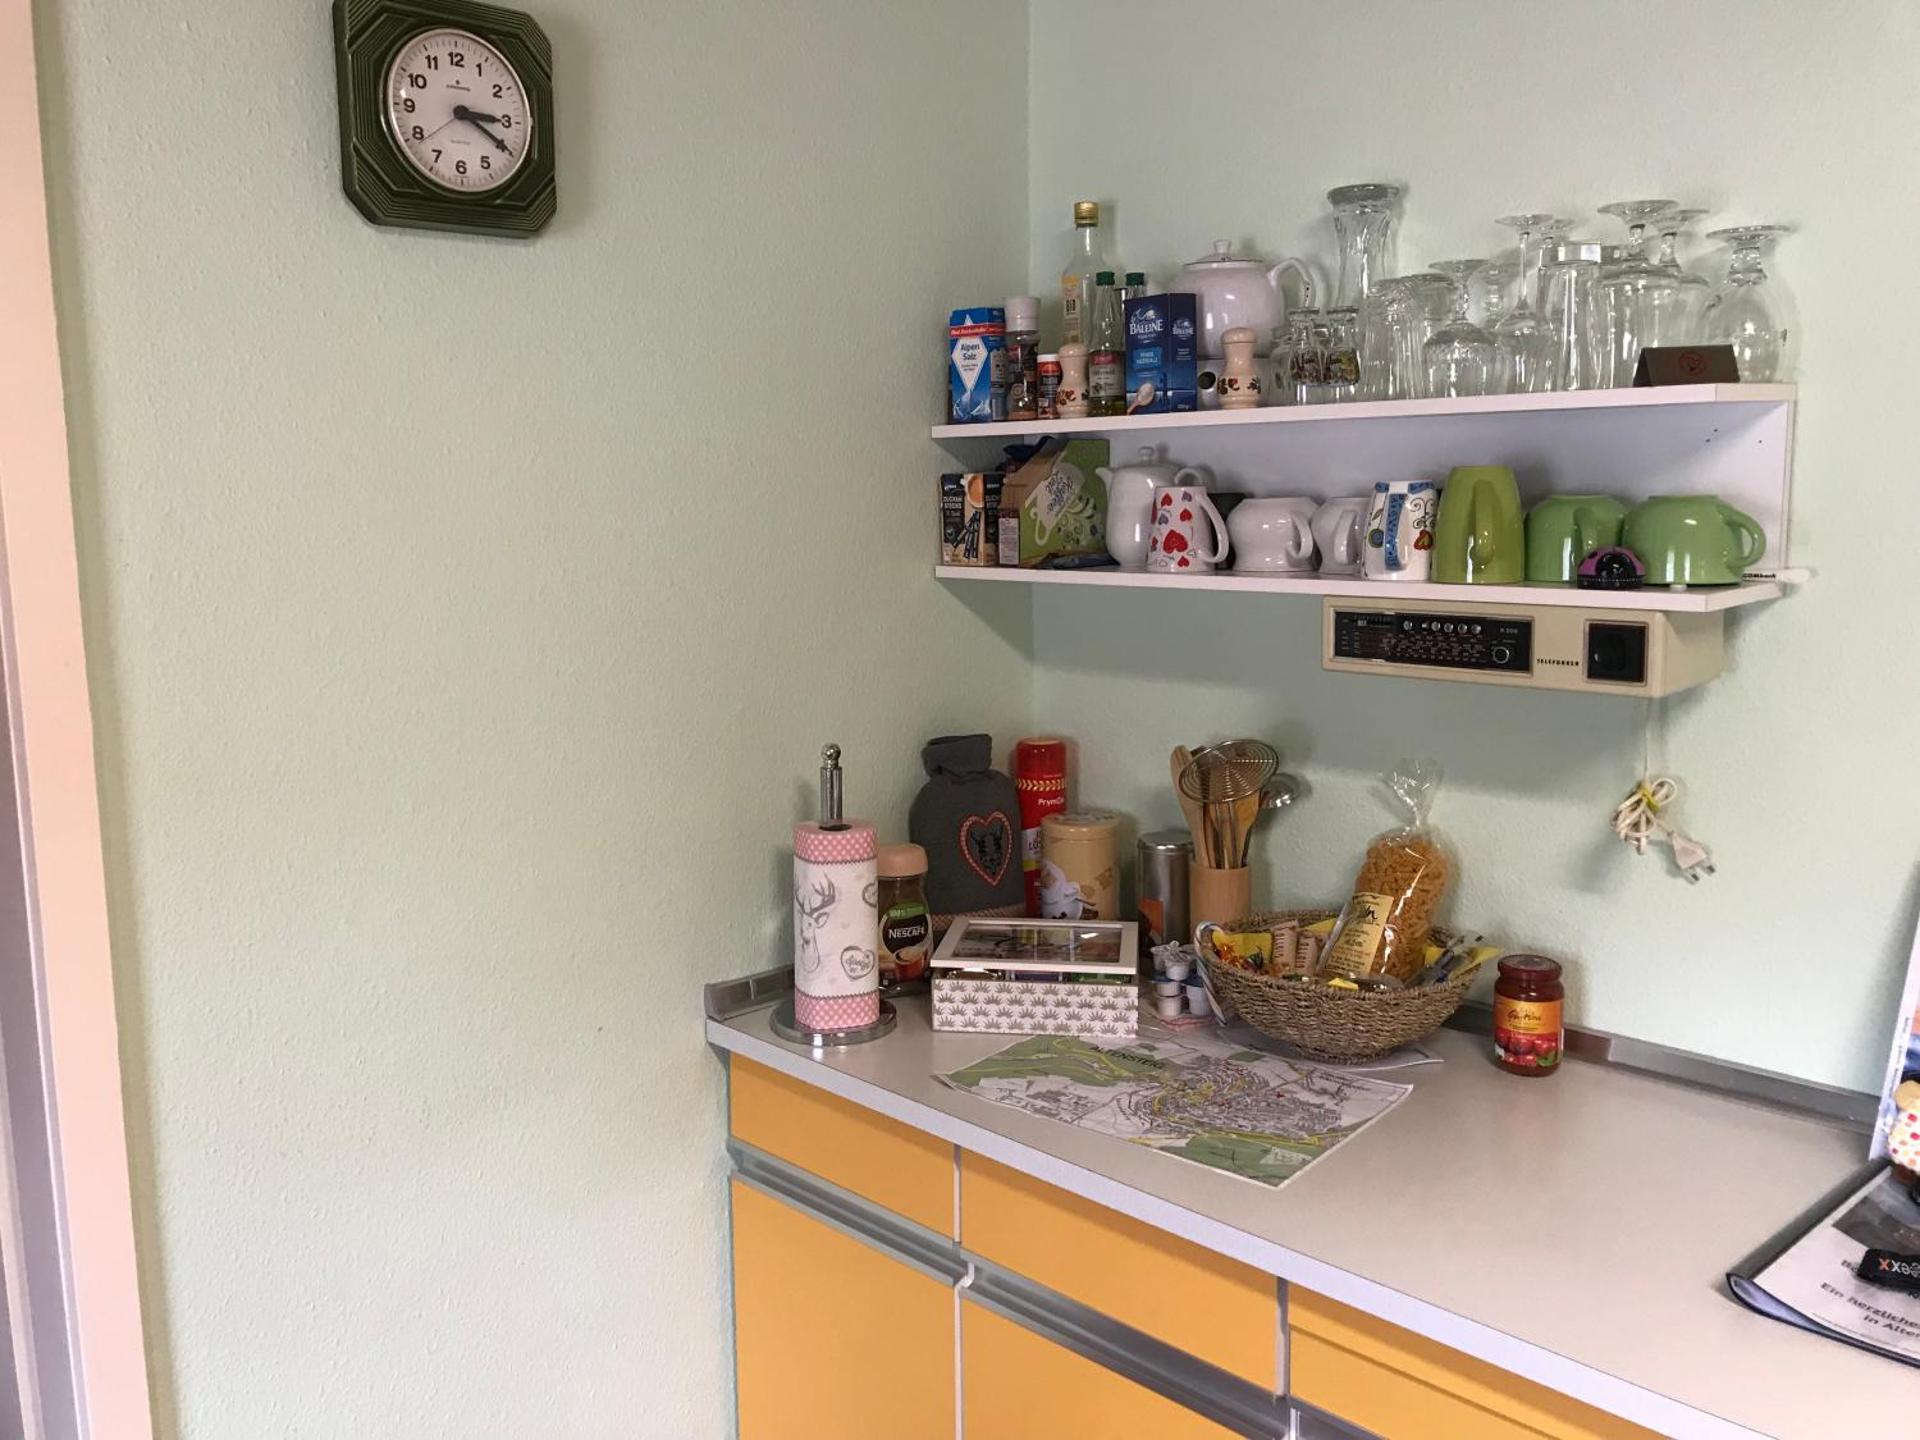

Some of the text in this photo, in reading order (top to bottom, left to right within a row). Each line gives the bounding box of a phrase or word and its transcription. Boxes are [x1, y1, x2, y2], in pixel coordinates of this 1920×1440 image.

[424, 54, 439, 71] 11
[448, 52, 465, 68] 12
[475, 62, 483, 77] 1
[407, 73, 427, 90] 10
[492, 84, 503, 99] 2
[403, 98, 416, 113] 9
[501, 114, 512, 129] 3
[411, 125, 425, 141] 8
[431, 149, 443, 163] 7
[480, 155, 491, 170] 5
[455, 160, 467, 175] 6
[960, 342, 980, 352] Alpen
[962, 351, 977, 361] Salz
[1820, 1282, 1920, 1329] Ein herzliche
[1864, 1315, 1879, 1325] in
